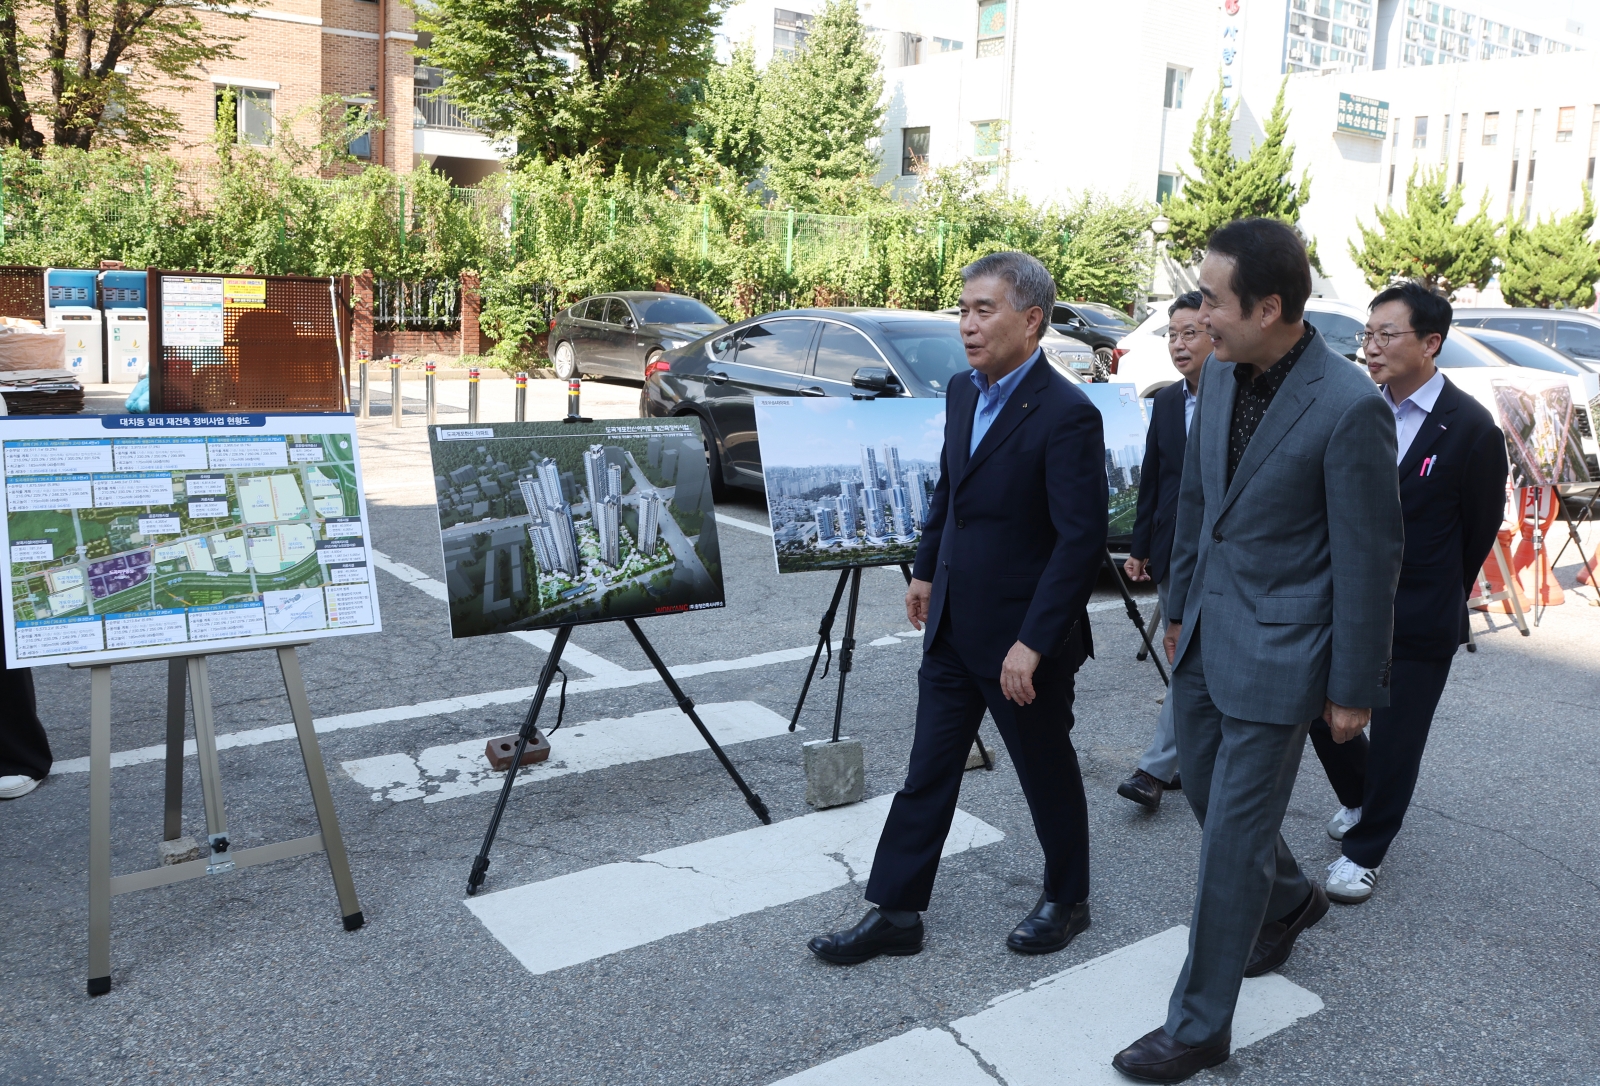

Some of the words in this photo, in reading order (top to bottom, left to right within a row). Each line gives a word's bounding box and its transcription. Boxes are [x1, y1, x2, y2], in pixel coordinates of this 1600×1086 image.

[119, 417, 145, 427] 대치동
[147, 417, 164, 427] 일대
[166, 417, 190, 426] 재건축
[193, 416, 224, 426] 정비사업
[227, 416, 250, 426] 현황도
